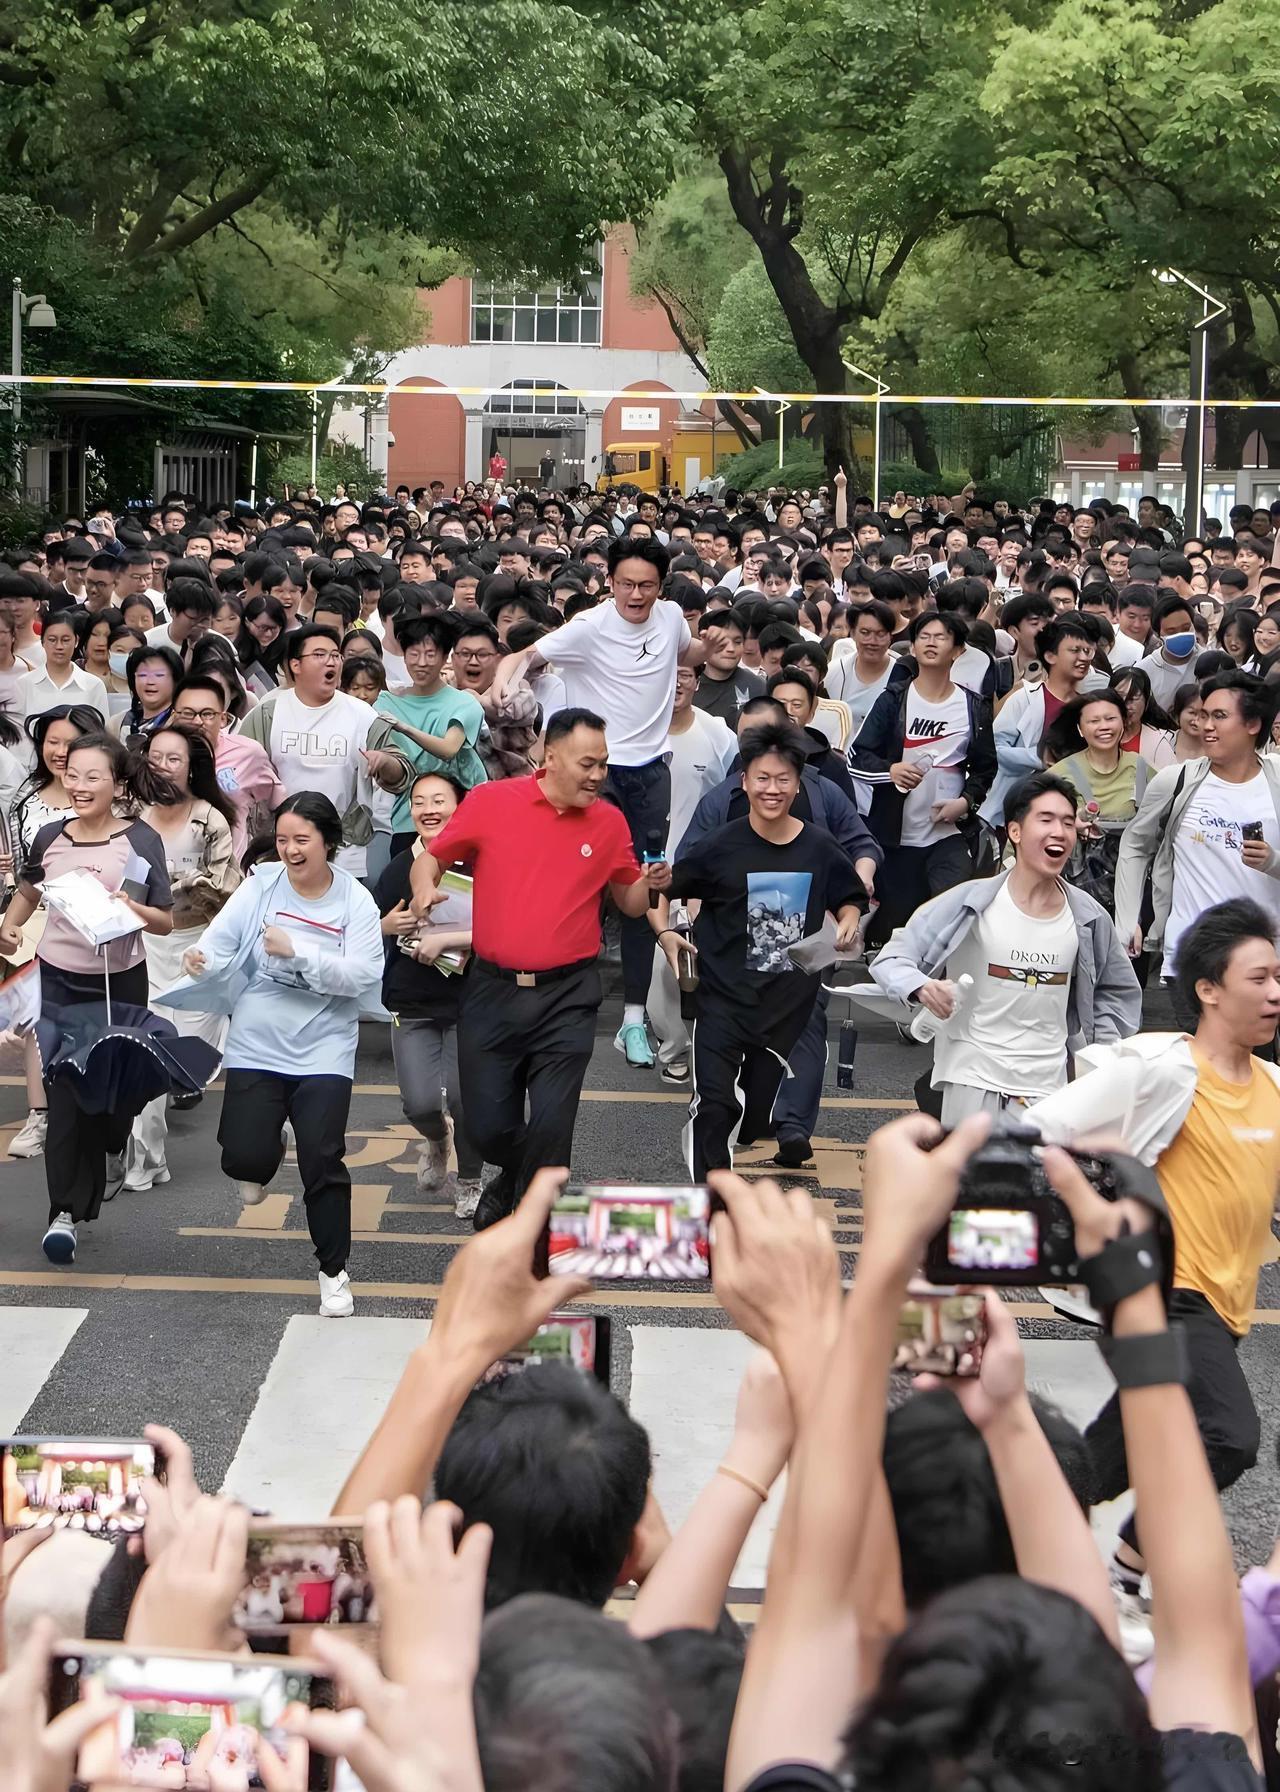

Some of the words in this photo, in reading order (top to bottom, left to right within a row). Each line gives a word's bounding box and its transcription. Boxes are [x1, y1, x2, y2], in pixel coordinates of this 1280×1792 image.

[908, 717, 949, 737] NIKE
[280, 730, 348, 757] FILA
[1010, 949, 1059, 965] DRONE
